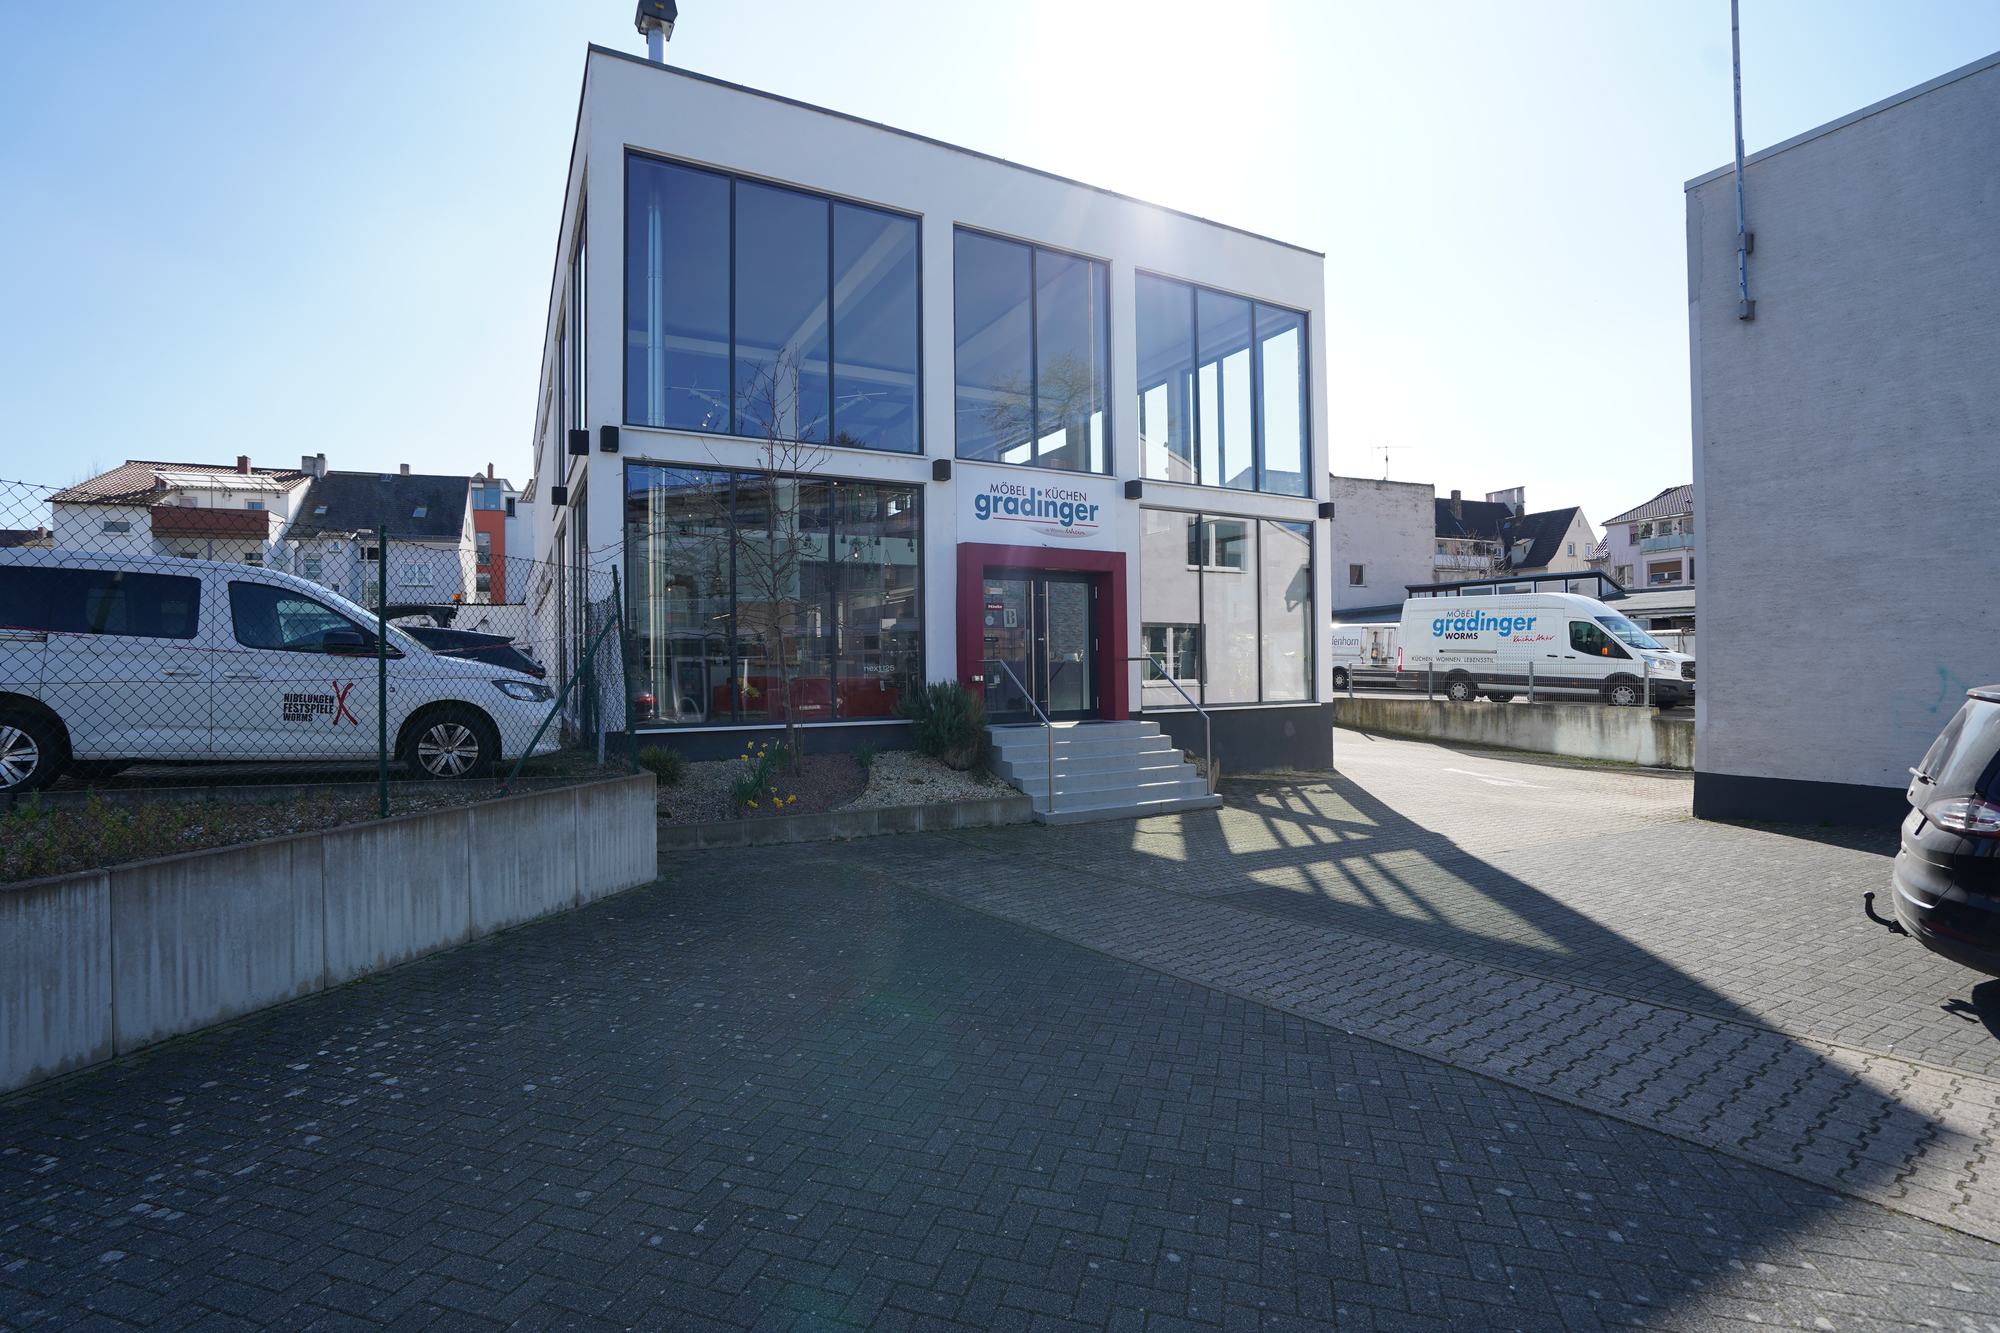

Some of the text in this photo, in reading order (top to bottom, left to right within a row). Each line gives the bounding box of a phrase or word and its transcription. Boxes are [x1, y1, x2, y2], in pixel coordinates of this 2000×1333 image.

[989, 482, 1087, 502] MÖBEL KÜCHEN
[974, 487, 1099, 527] gradinger
[1446, 609, 1474, 618] MÖBEL
[1432, 610, 1537, 637] gradinger
[1445, 632, 1479, 640] WORMS
[283, 693, 335, 704] NIBELUNGEN
[283, 703, 334, 714] FESTSPIELE
[283, 713, 313, 722] WORMS
